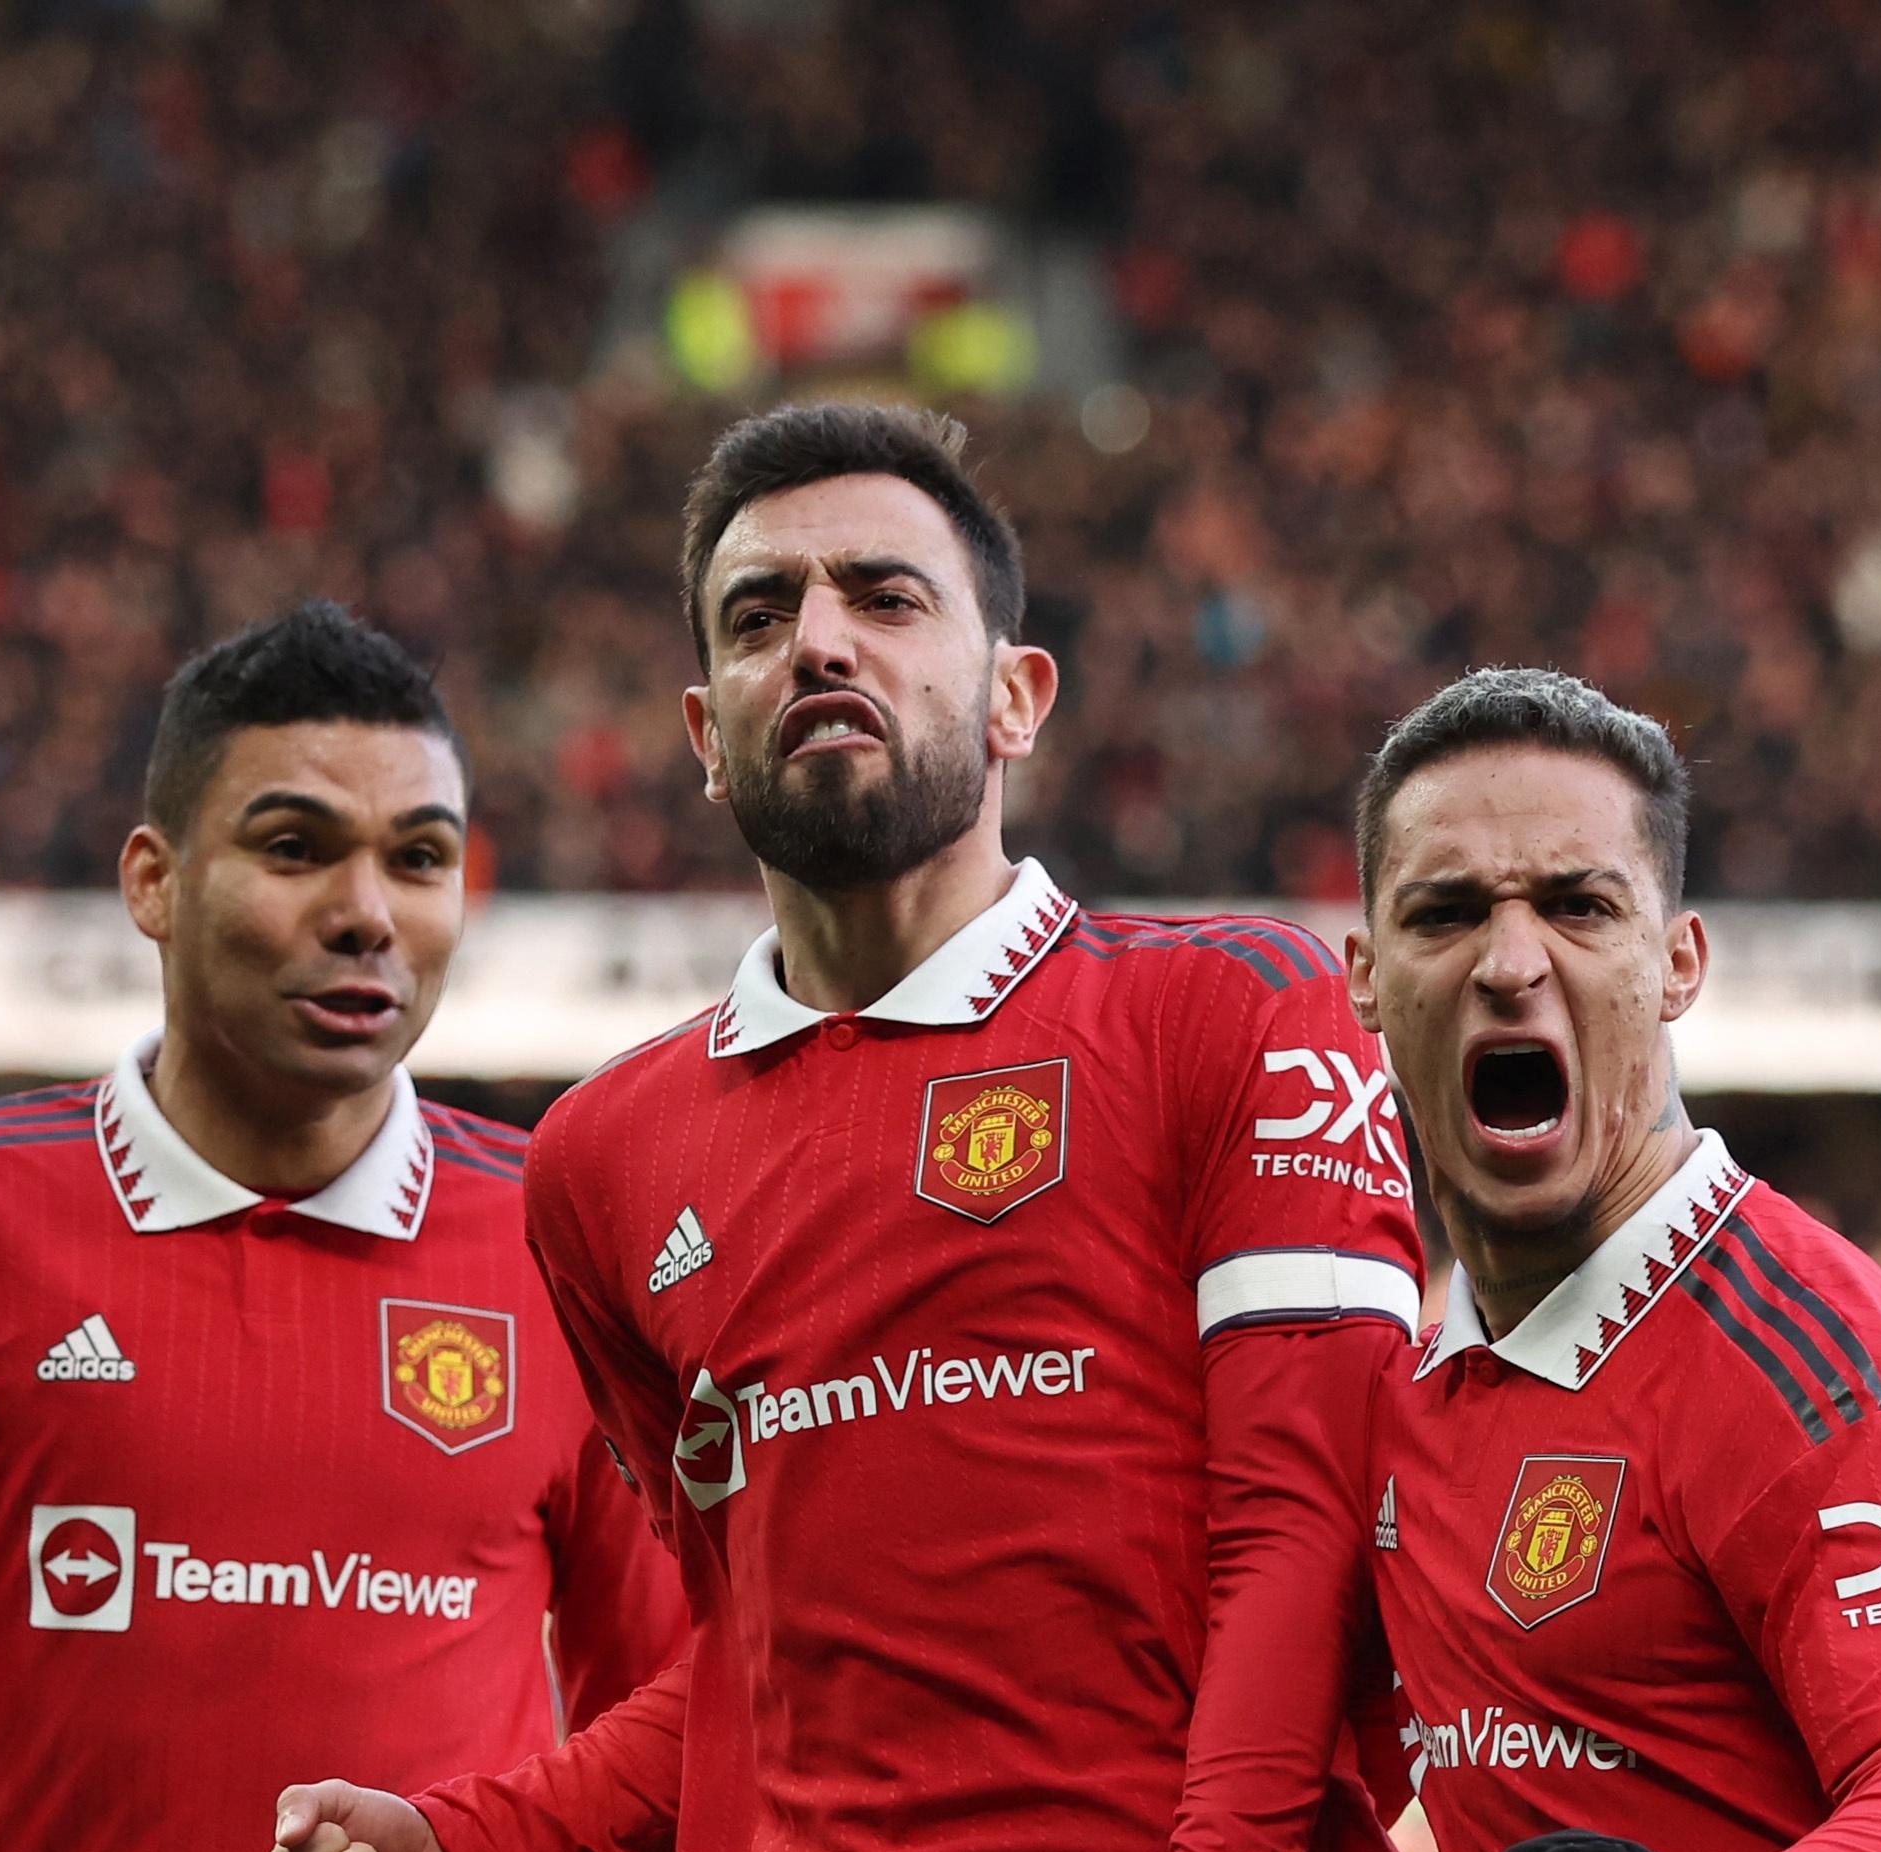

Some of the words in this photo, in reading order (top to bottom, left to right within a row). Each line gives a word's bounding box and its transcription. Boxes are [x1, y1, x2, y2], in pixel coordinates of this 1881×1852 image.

[948, 1093, 1041, 1135] MANCHESTER
[957, 1165, 1024, 1188] UNITED
[1251, 1152, 1414, 1199] TECHNOLO
[648, 1241, 714, 1294] adidas
[37, 1358, 136, 1382] adidas
[421, 1397, 483, 1422] UNITED
[735, 1347, 1096, 1444] TeamViewer
[1522, 1484, 1596, 1527] MANCHESTER
[143, 1541, 479, 1620] TeamViewer
[1513, 1571, 1569, 1591] UNITED
